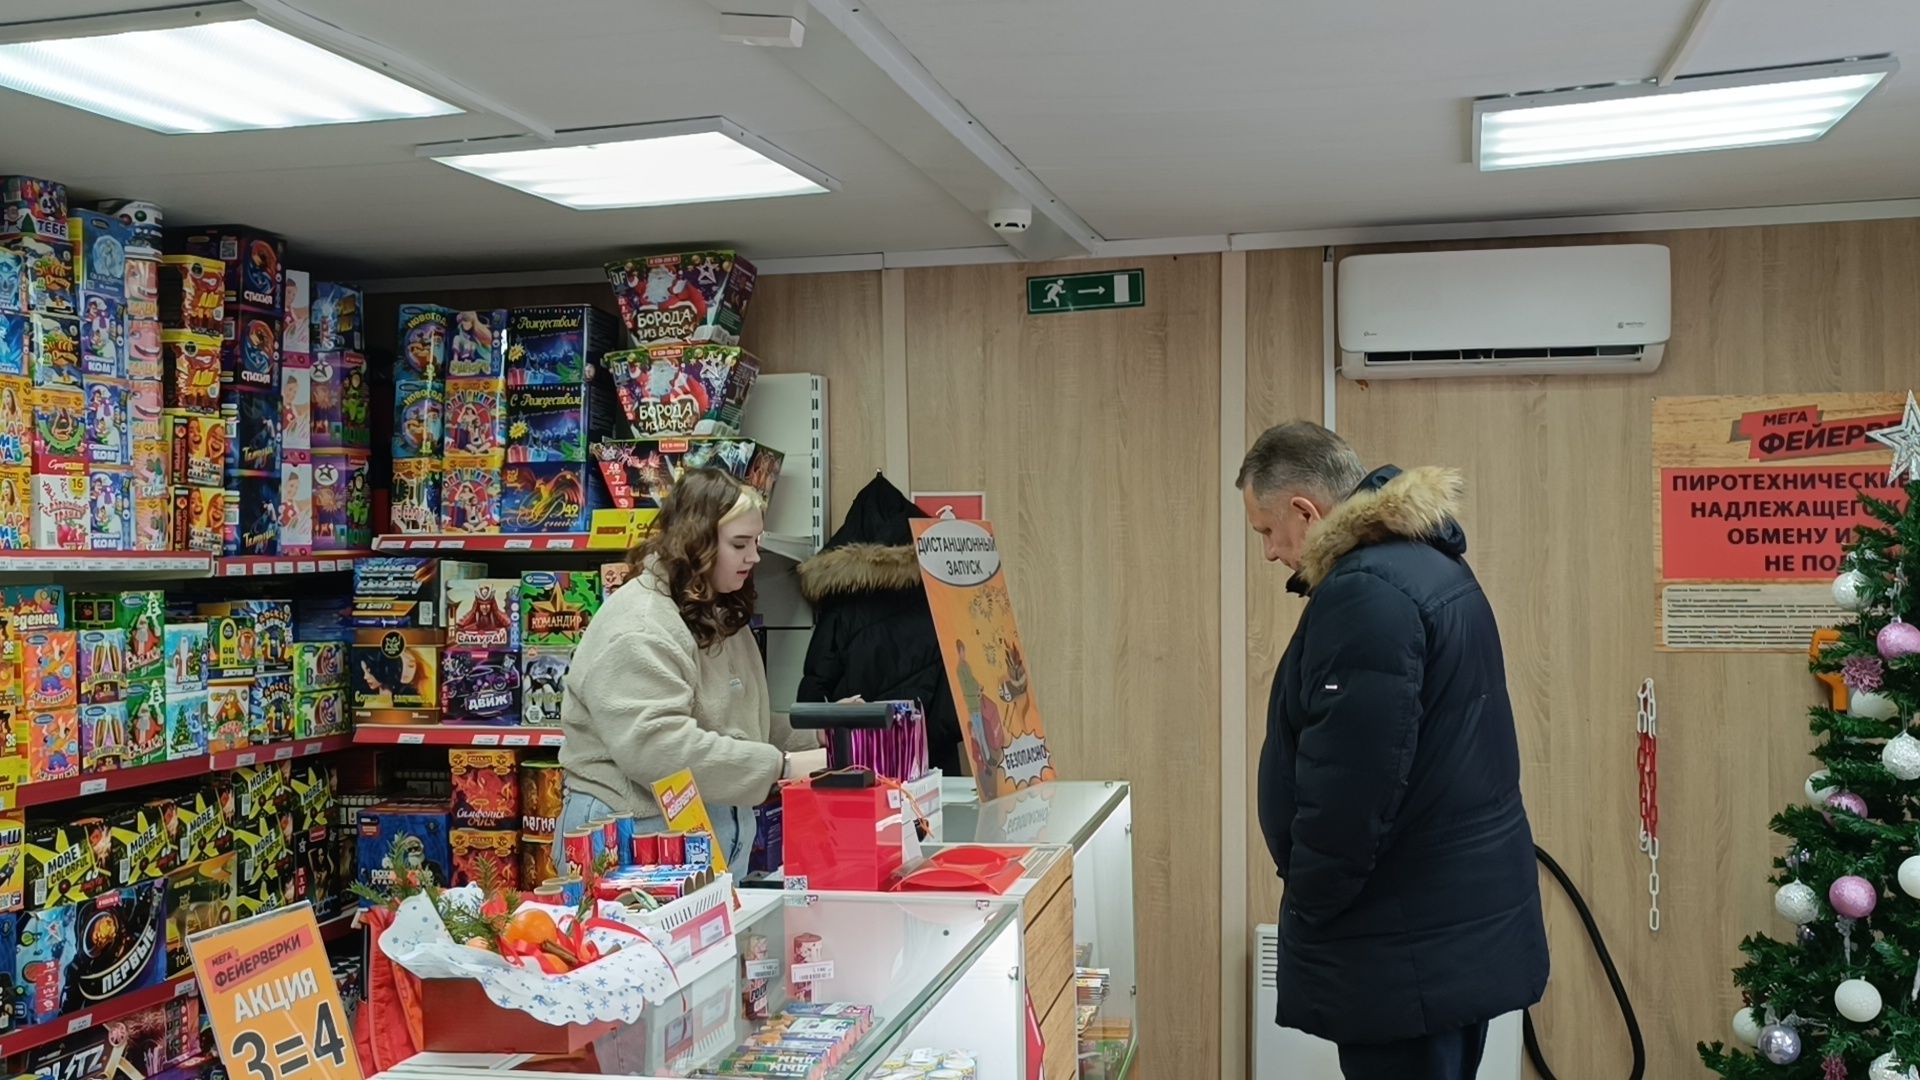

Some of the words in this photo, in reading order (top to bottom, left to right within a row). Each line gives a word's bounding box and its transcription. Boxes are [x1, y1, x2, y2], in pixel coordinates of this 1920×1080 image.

[37, 220, 67, 236] ТЕБЕ
[637, 308, 692, 328] БОРОДА
[640, 402, 693, 419] БОРОДА
[1762, 410, 1809, 427] МЕГА
[1758, 420, 1902, 454] ФЕЙЕР
[92, 450, 117, 461] КОМ
[72, 478, 84, 489] 16
[1672, 471, 1910, 492] ПИРОТЕХНИЧЕСКИЕ
[93, 538, 117, 549] КОМ
[917, 534, 997, 556] ДИСТАНЦИОННЫЙ
[1727, 527, 1828, 545] ОБМЕНУ
[1835, 527, 1851, 544] И
[946, 560, 983, 575] ЗАПУСК
[1764, 555, 1795, 571] НЕ
[13, 612, 59, 630] еденец
[531, 614, 583, 629] КОМАНДИР
[456, 631, 508, 645] САМУРАЙ
[468, 693, 508, 710] ДВИЖ
[1005, 744, 1047, 769] БЕЗОПАСНО
[250, 767, 272, 789] MORE
[189, 806, 214, 832] MORE
[130, 825, 156, 854] MORE
[133, 834, 164, 862] COLORFUL
[254, 829, 275, 854] MORE
[47, 847, 79, 874] MORE
[50, 856, 90, 884] COLORFUL
[211, 951, 233, 967] МЕГА
[234, 967, 319, 1024] АКЦИЯ
[230, 998, 346, 1080] 3=4
